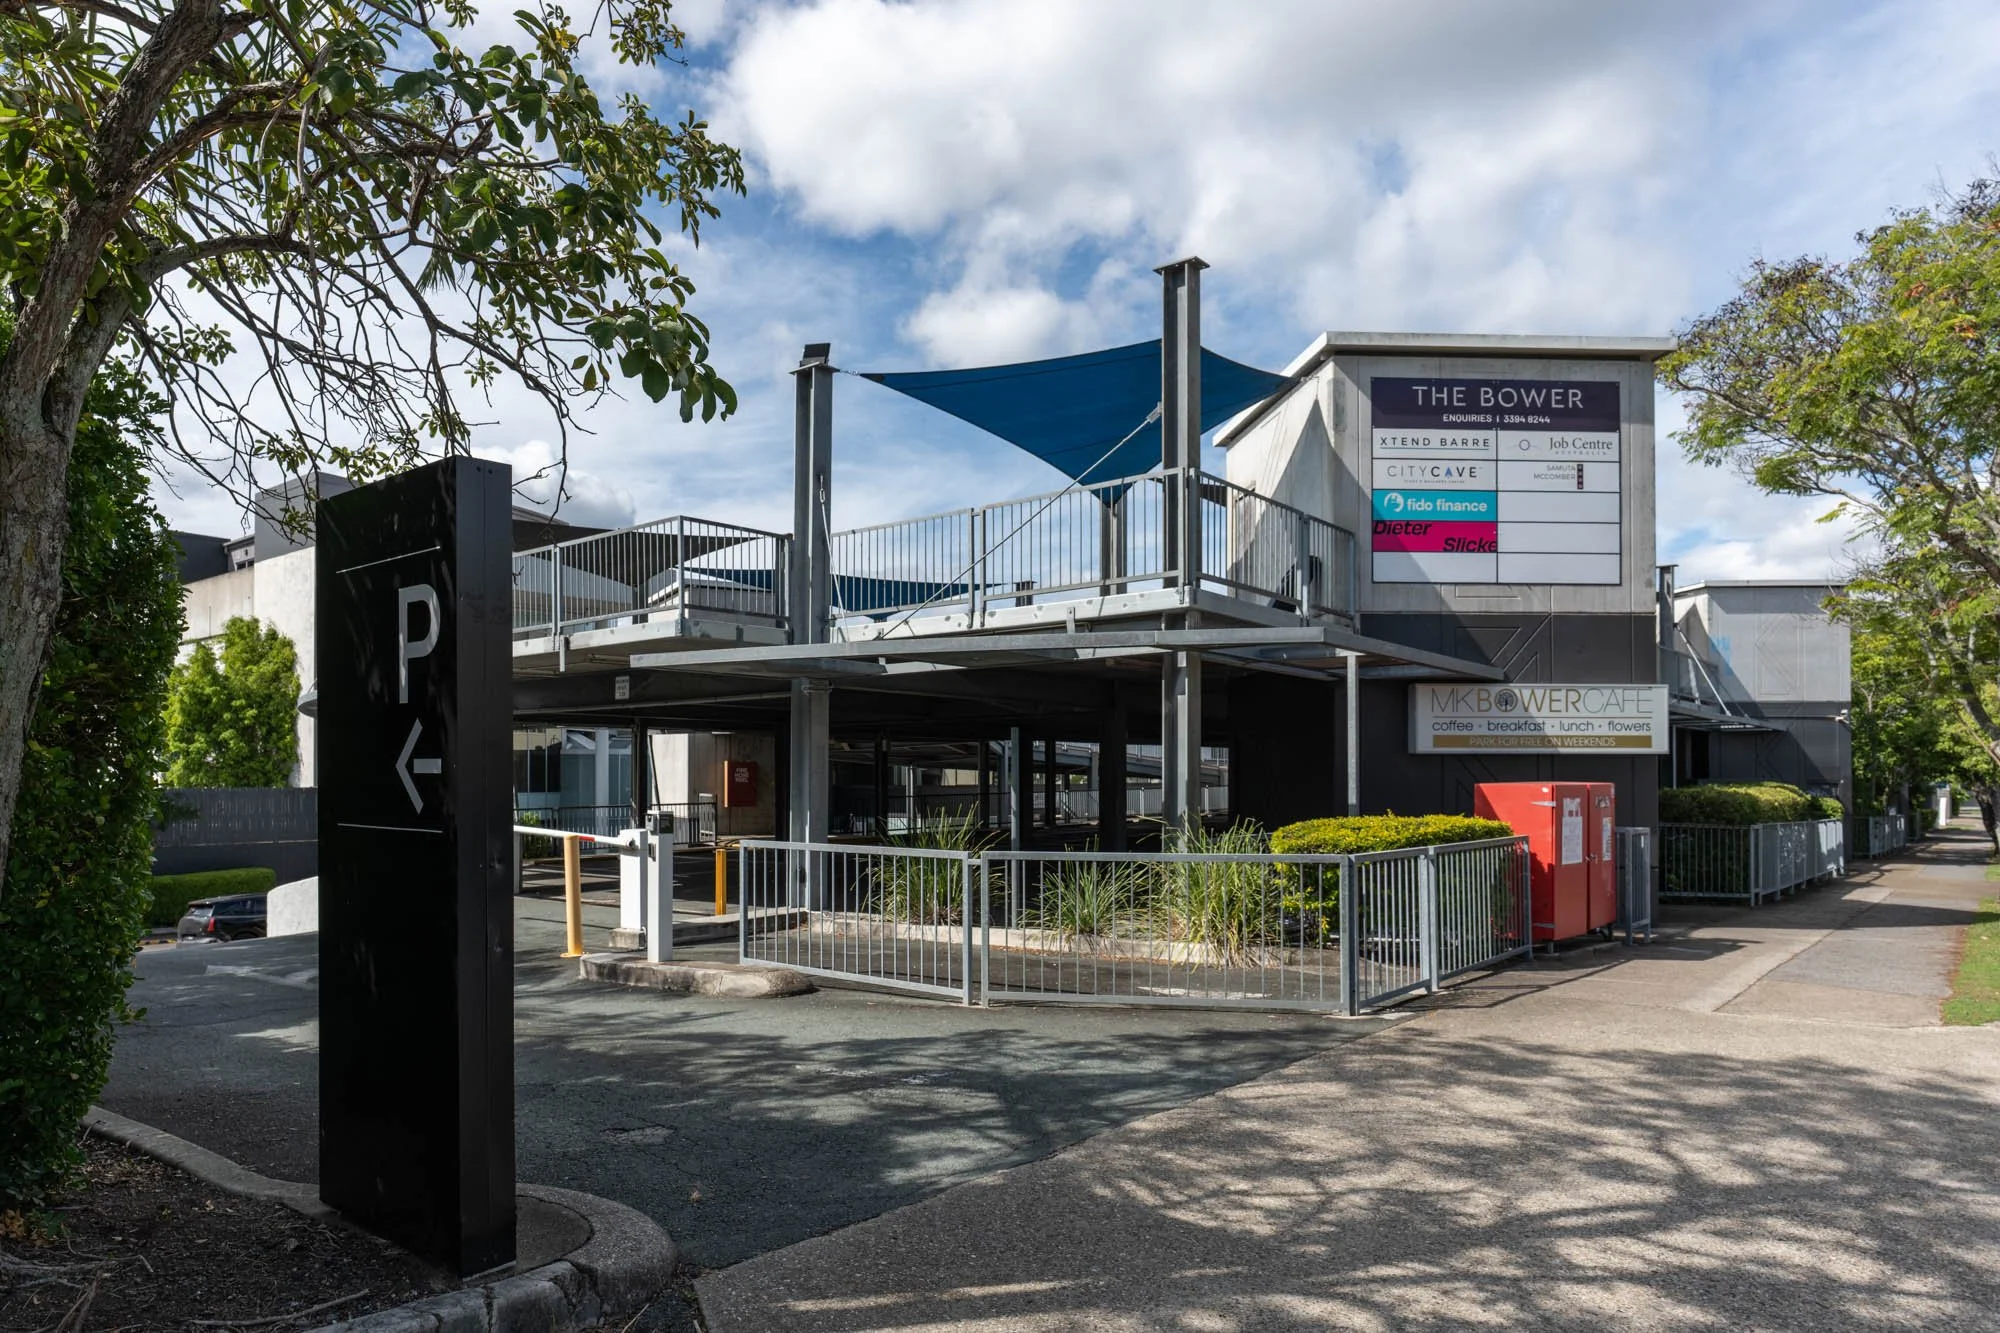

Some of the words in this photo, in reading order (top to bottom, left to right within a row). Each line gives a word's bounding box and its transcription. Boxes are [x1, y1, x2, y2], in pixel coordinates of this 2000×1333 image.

[1412, 386, 1466, 406] THE
[1480, 387, 1584, 409] BOWER
[1443, 413, 1492, 423] ENQUIRIES
[1503, 414, 1526, 424] 3394
[1527, 415, 1551, 424] 8244
[1380, 436, 1431, 447] XTEND
[1440, 438, 1490, 448] BARRE
[1549, 436, 1569, 451] Job
[1572, 437, 1614, 450] Centre
[1407, 498, 1433, 512] fido
[1436, 498, 1488, 512] finance
[1373, 520, 1432, 536] Dieter
[398, 583, 441, 704] P
[1431, 719, 1474, 732] coffee
[1487, 719, 1546, 732] breakfast
[1559, 720, 1595, 732] lunch
[1607, 720, 1652, 732] flowers
[1469, 735, 1496, 746] PARK
[1520, 735, 1543, 746] FREE
[1545, 736, 1561, 746] ON
[1563, 736, 1617, 747] WEEKENDS
